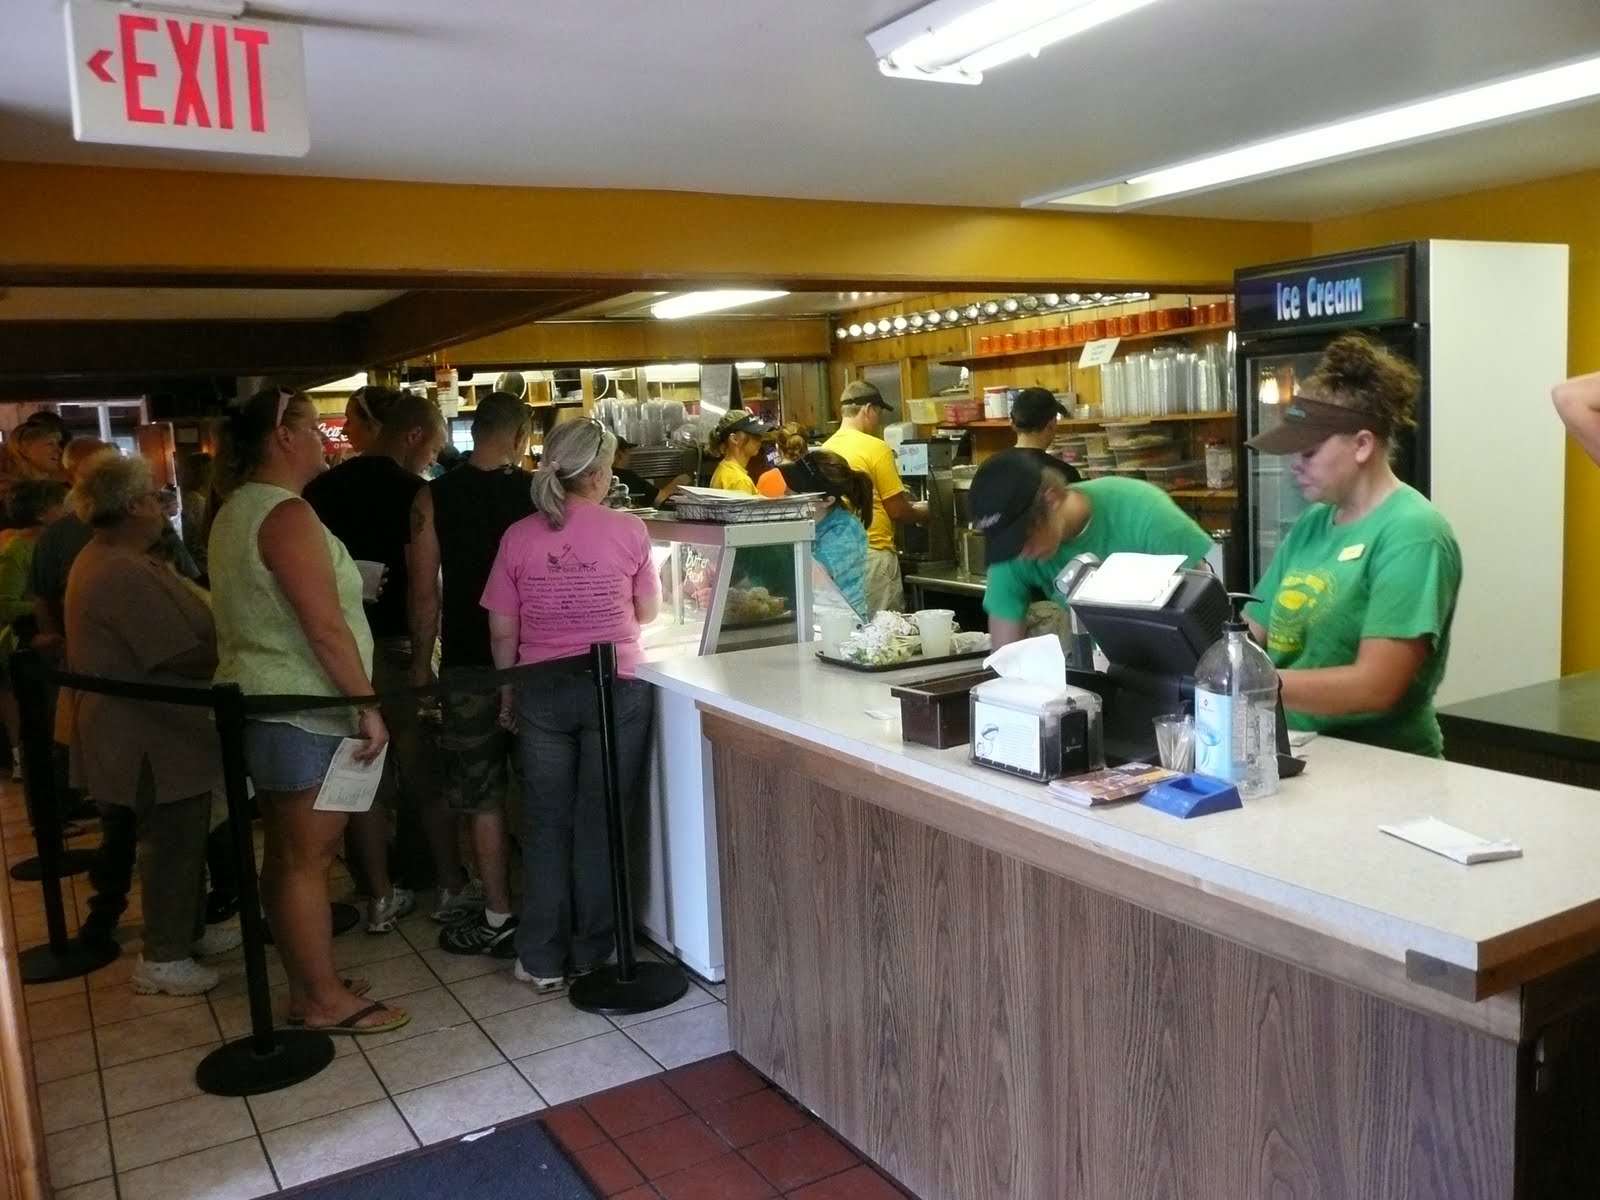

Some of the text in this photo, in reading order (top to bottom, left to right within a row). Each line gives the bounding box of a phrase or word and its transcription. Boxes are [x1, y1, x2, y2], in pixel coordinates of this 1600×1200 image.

[119, 14, 269, 133] EXIT
[1276, 277, 1363, 321] Ice Cream
[563, 566, 597, 574] SKELETON
